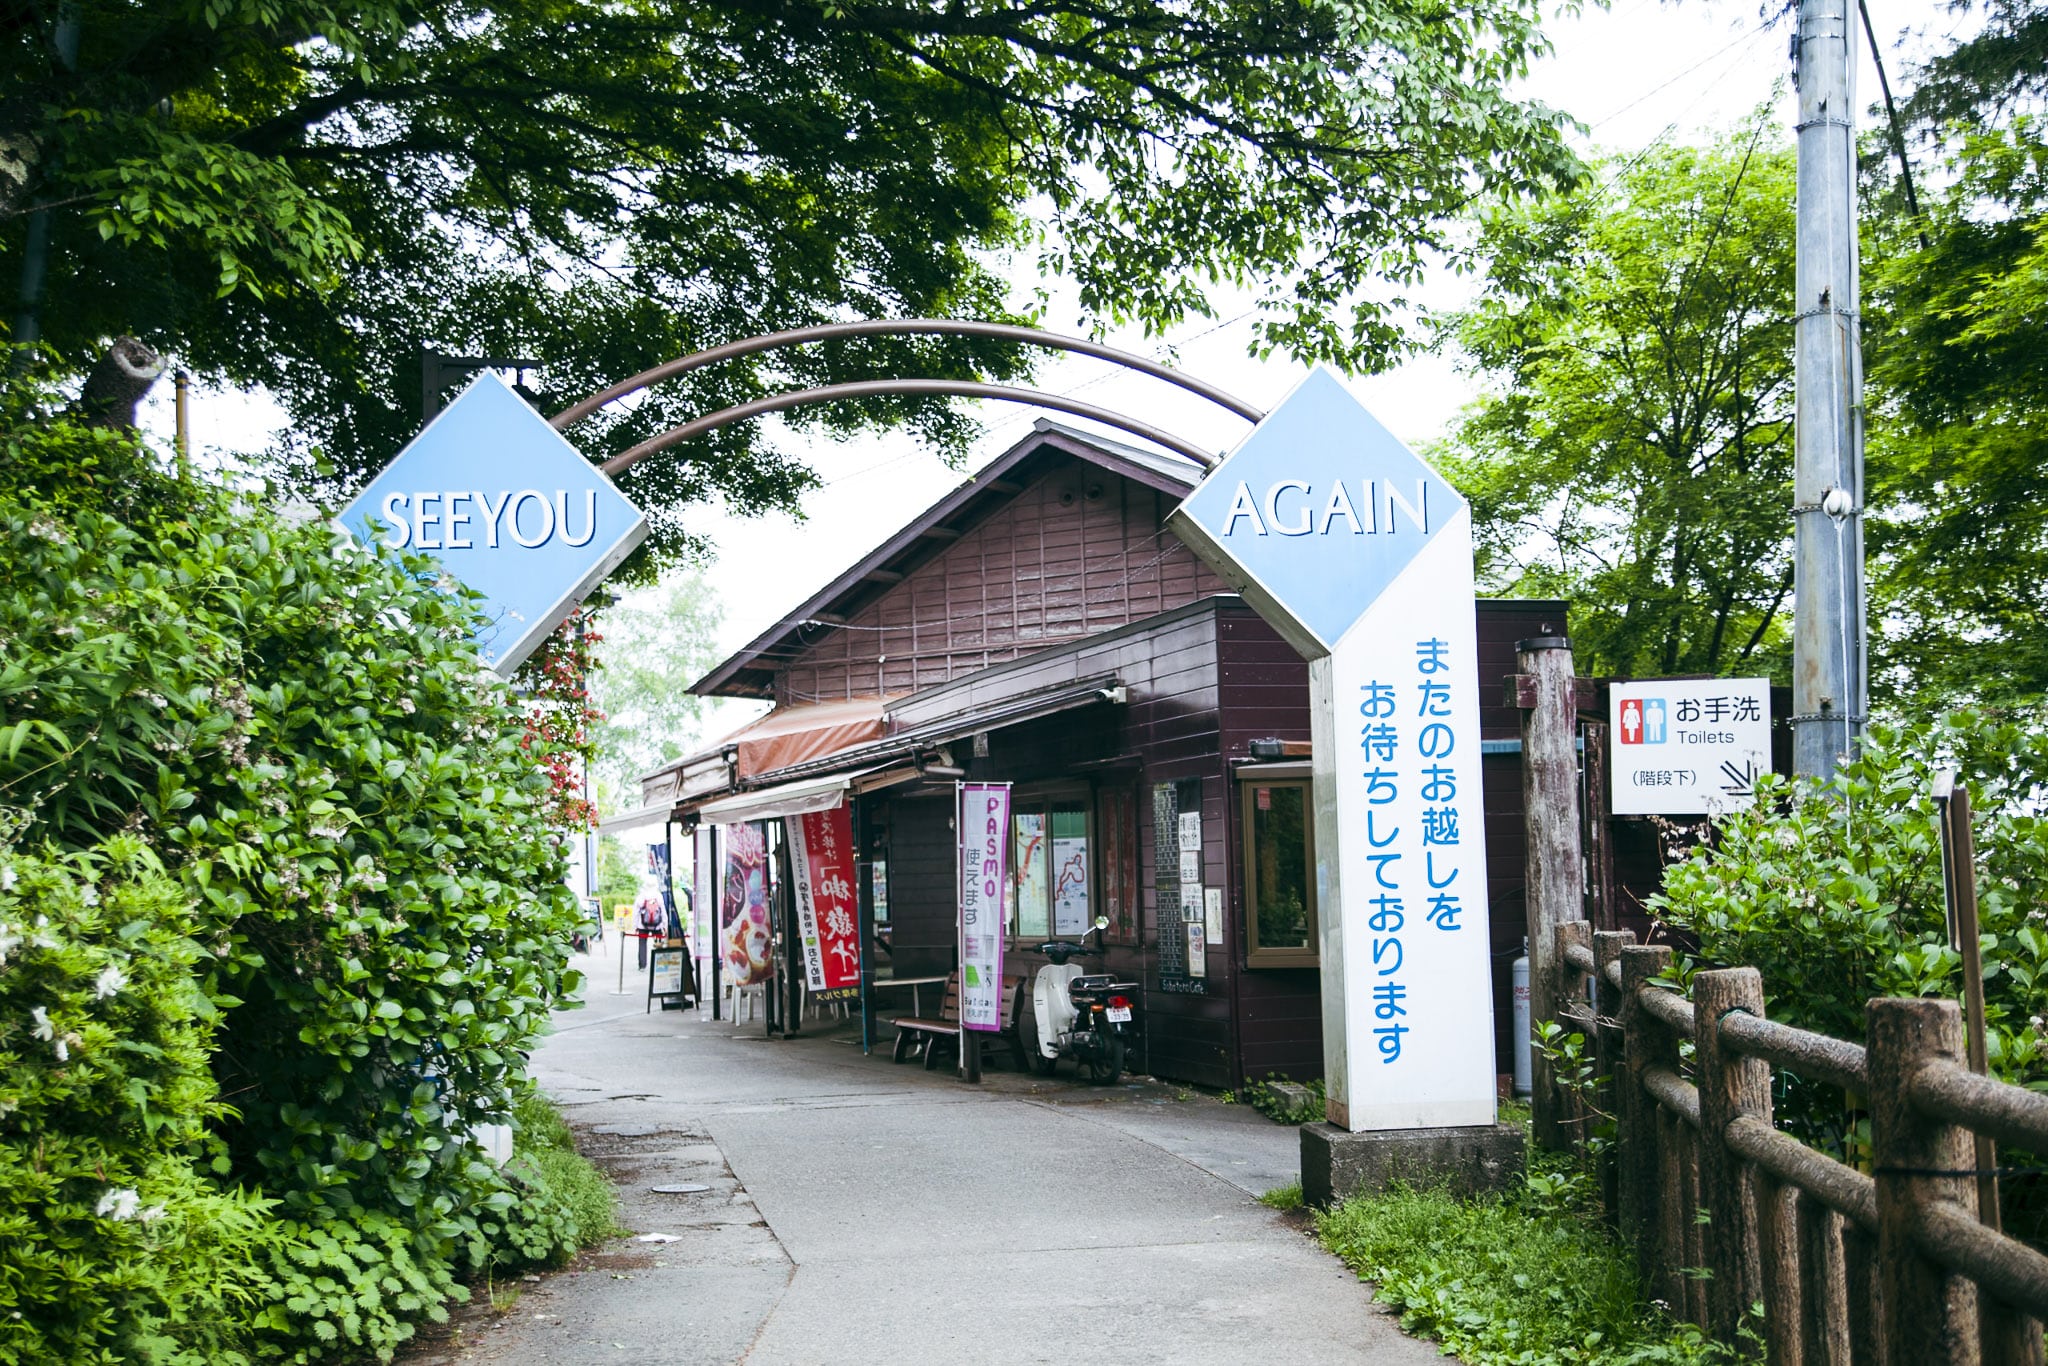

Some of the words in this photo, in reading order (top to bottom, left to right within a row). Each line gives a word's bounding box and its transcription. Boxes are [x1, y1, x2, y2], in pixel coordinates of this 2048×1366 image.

[380, 488, 597, 550] SEEYOU
[1220, 478, 1429, 537] AGAIN
[1676, 695, 1761, 723] お手洗
[1676, 730, 1735, 744] Toilets
[1415, 637, 1463, 931] またのお越しを
[983, 797, 999, 898] PASMO
[1359, 679, 1410, 1064] お待ちしております
[965, 848, 981, 925] 使えます
